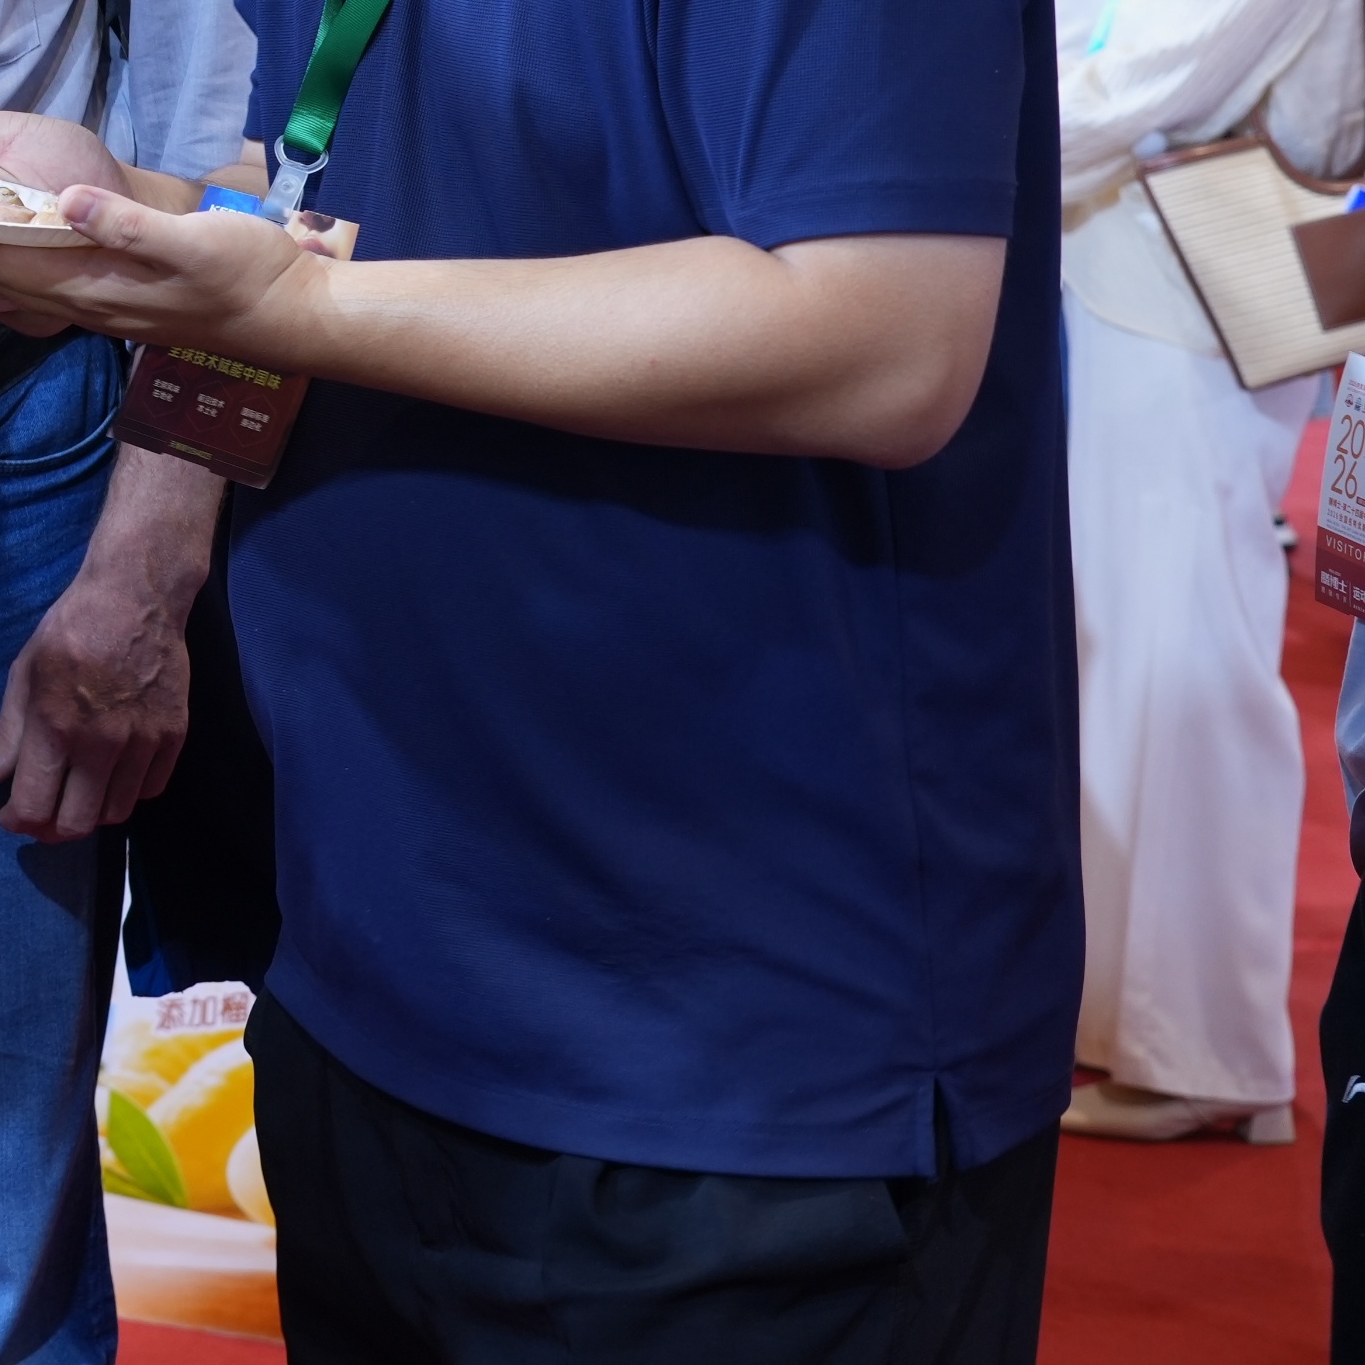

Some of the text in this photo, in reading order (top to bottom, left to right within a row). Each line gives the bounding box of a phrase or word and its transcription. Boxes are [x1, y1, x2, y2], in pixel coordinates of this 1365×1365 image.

[1336, 415, 1365, 459] 20
[1331, 455, 1358, 499] 26
[1326, 535, 1365, 562] VISITO
